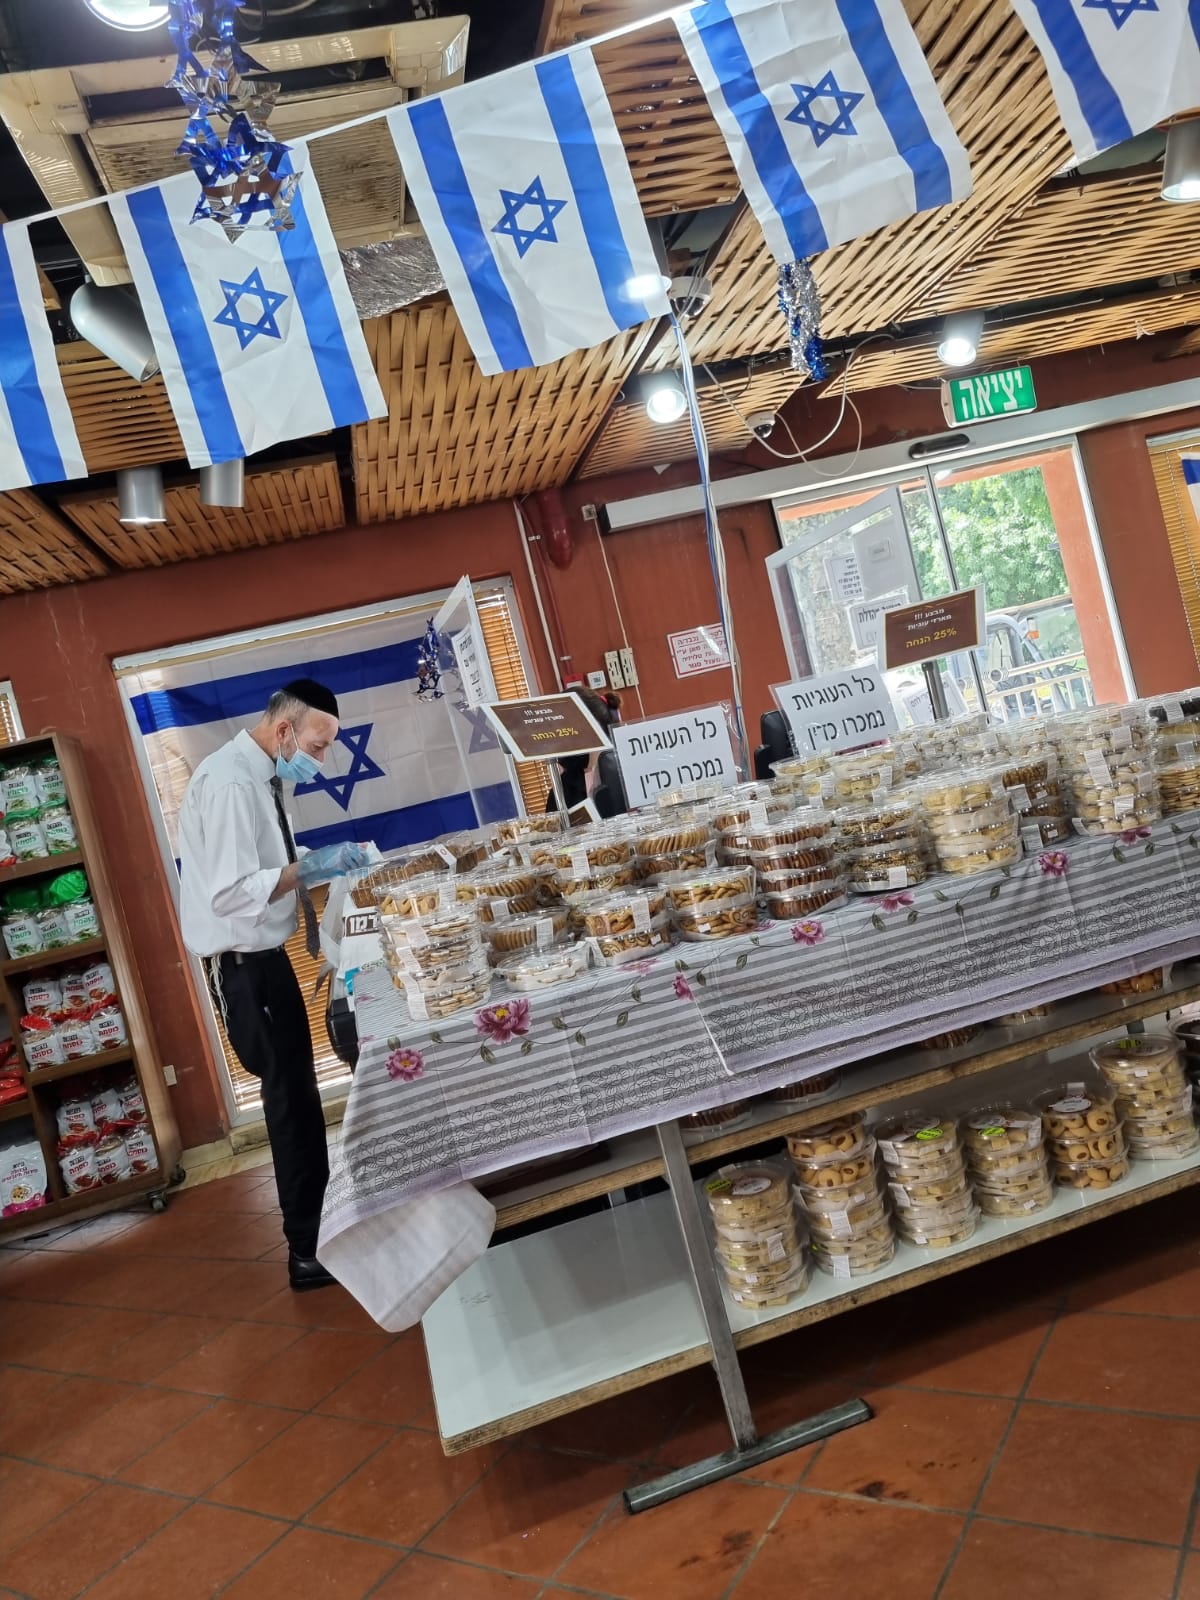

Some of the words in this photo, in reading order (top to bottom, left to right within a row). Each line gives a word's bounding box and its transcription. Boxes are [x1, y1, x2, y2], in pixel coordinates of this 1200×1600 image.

[959, 370, 1022, 419] יציאה
[925, 608, 945, 617] מבצע
[930, 614, 952, 624] מארזי
[907, 620, 929, 631] עוגיות
[934, 628, 957, 640] 25%
[906, 636, 931, 648] הנחה
[851, 674, 875, 694] כל
[792, 683, 853, 710] העוגיות
[534, 708, 553, 716] מבצע
[556, 728, 578, 737] 25%
[694, 718, 717, 740] כל
[842, 710, 886, 736] נמכרו
[531, 732, 556, 740] הנחה
[628, 726, 692, 756] העוגיות
[807, 722, 838, 750] כדין
[677, 758, 724, 784] נמכרו
[640, 770, 672, 798] כדין
